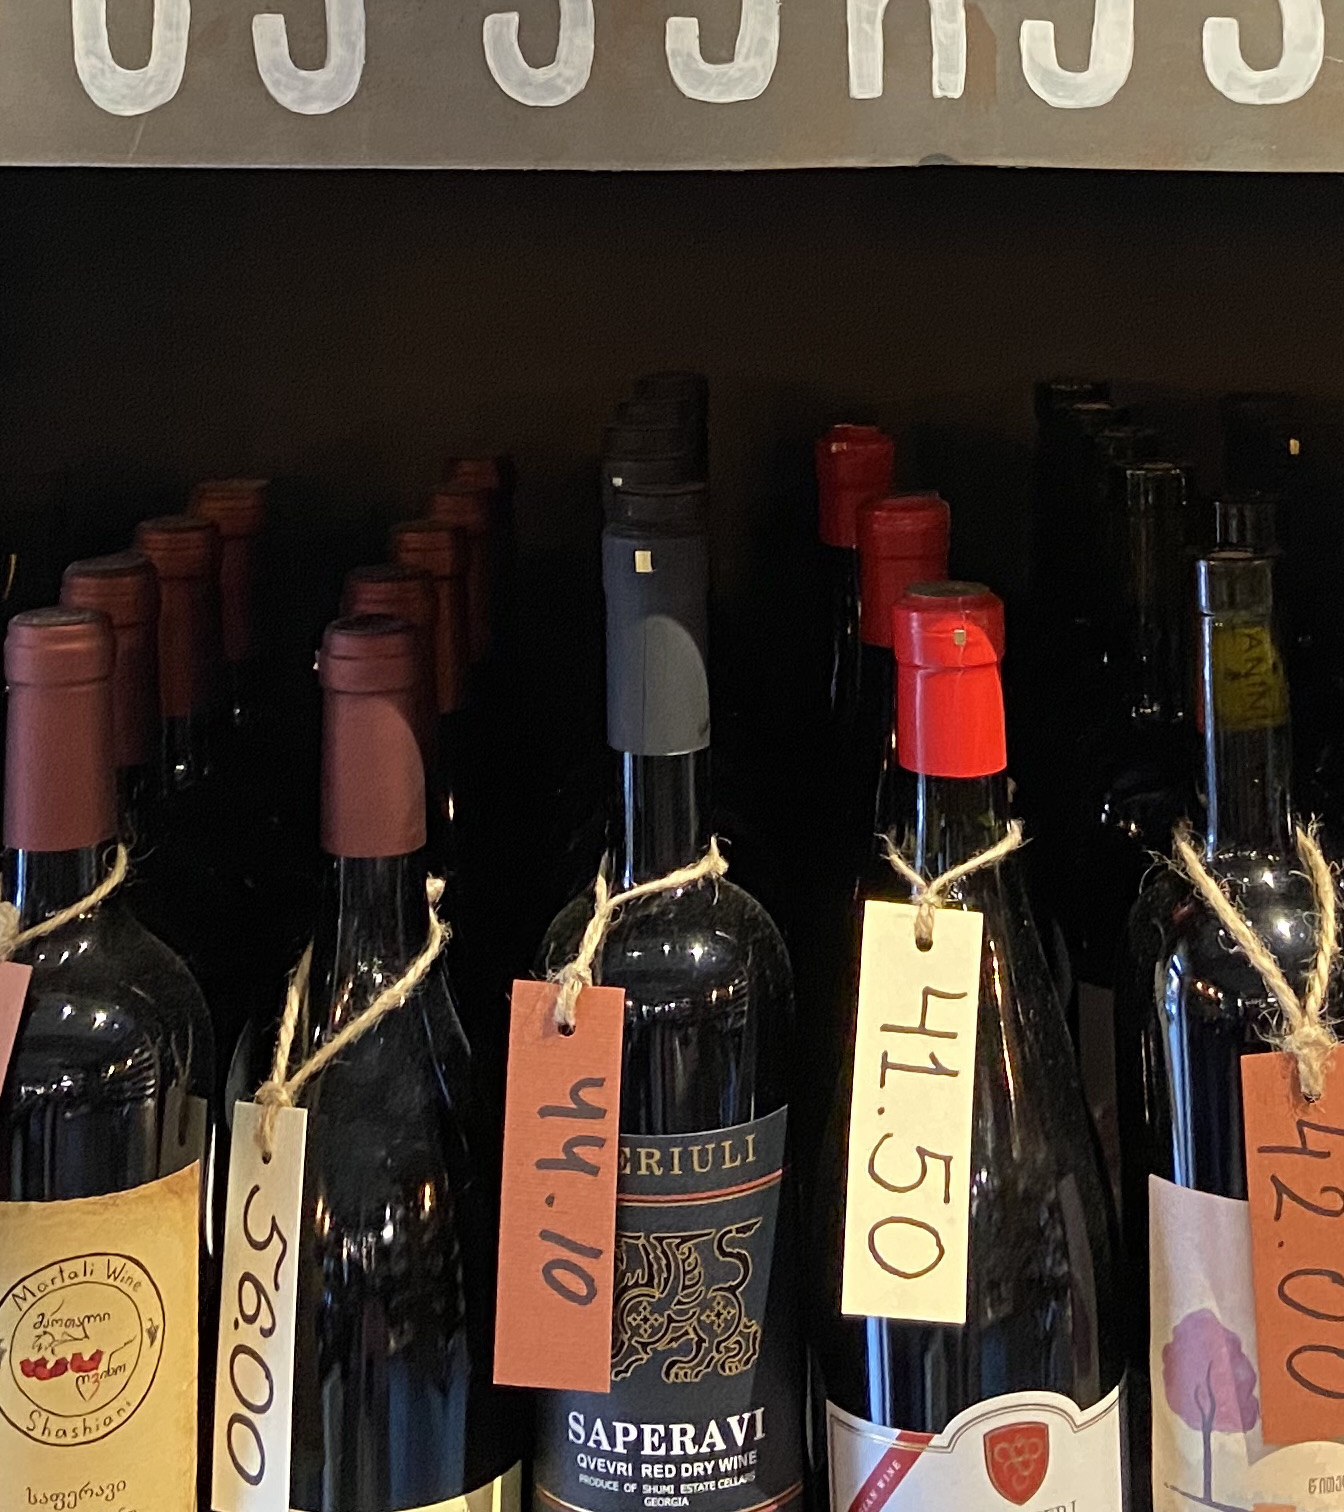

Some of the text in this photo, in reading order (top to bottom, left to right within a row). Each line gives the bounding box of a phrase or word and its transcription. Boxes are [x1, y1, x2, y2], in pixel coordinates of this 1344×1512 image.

[867, 985, 968, 1280] 41.50
[535, 1076, 608, 1306] 44.10
[10, 1258, 143, 1312] Martali Wine
[226, 1184, 288, 1486] 56.00
[24, 1399, 132, 1441] Shashiani
[568, 1407, 767, 1456] SAPERAVI
[576, 1450, 758, 1479] QVEVRI RED DRY WINE
[25, 1478, 128, 1510] საფერავი
[624, 1482, 638, 1494] OF
[642, 1484, 675, 1495] SHUMI
[680, 1480, 716, 1495] ESTATE
[644, 1496, 690, 1507] GEORGIA
